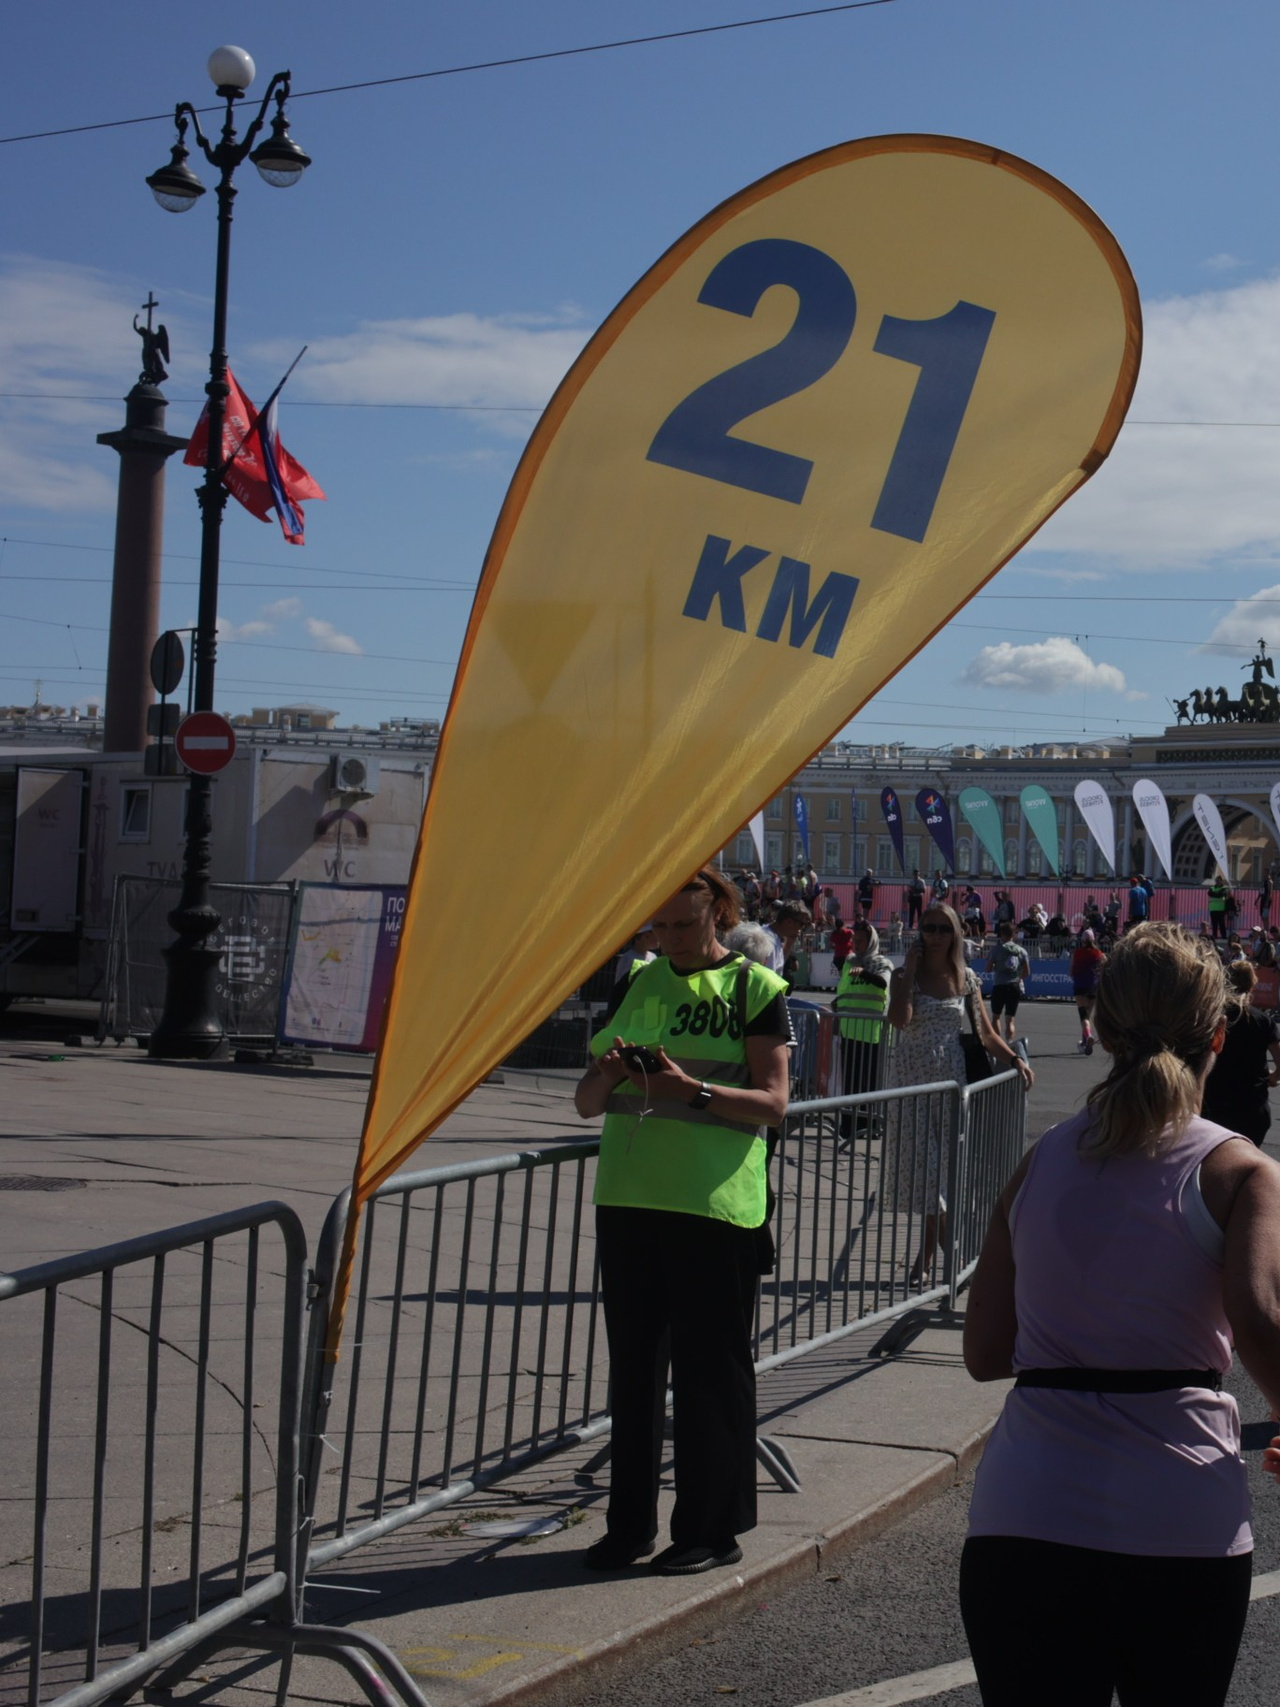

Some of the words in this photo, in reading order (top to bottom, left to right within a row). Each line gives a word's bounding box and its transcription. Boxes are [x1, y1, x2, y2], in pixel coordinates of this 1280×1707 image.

[645, 238, 997, 544] 21
[682, 533, 860, 659] KM
[1031, 971, 1073, 984] ИНГОССТРА
